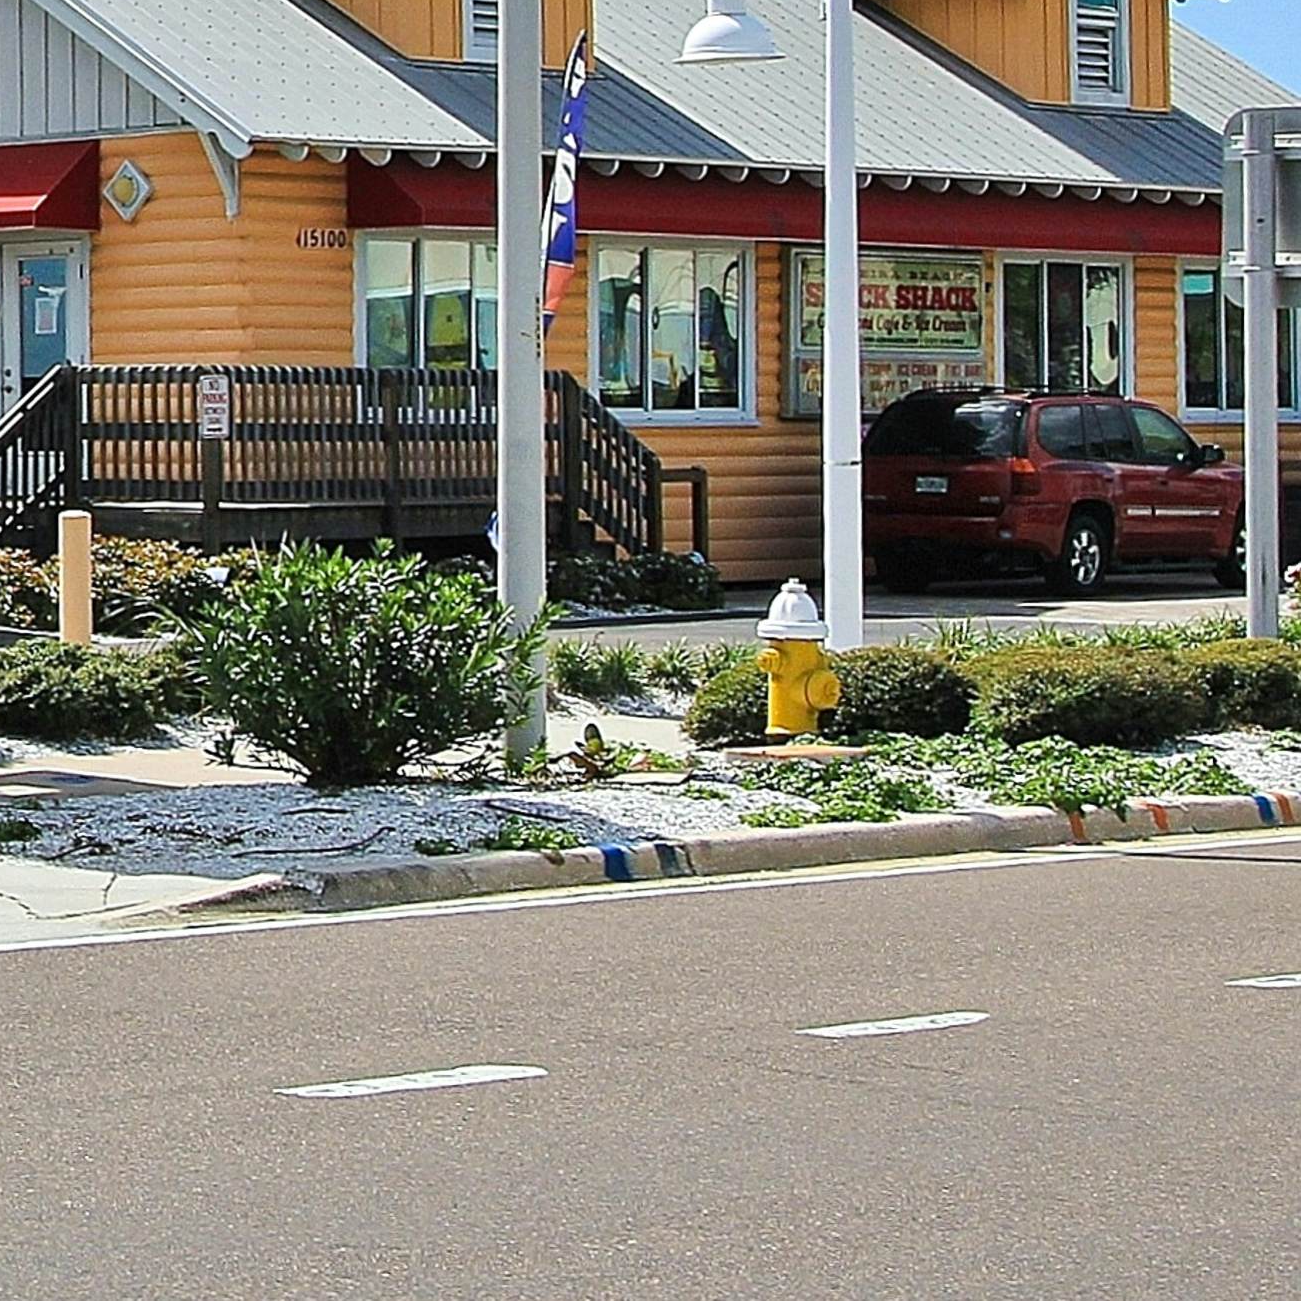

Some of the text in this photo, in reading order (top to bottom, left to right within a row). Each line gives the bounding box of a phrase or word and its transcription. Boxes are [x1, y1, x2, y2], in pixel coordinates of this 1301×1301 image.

[303, 229, 347, 248] 15100
[805, 282, 978, 312] SCK SHACK
[933, 315, 967, 332] Cream
